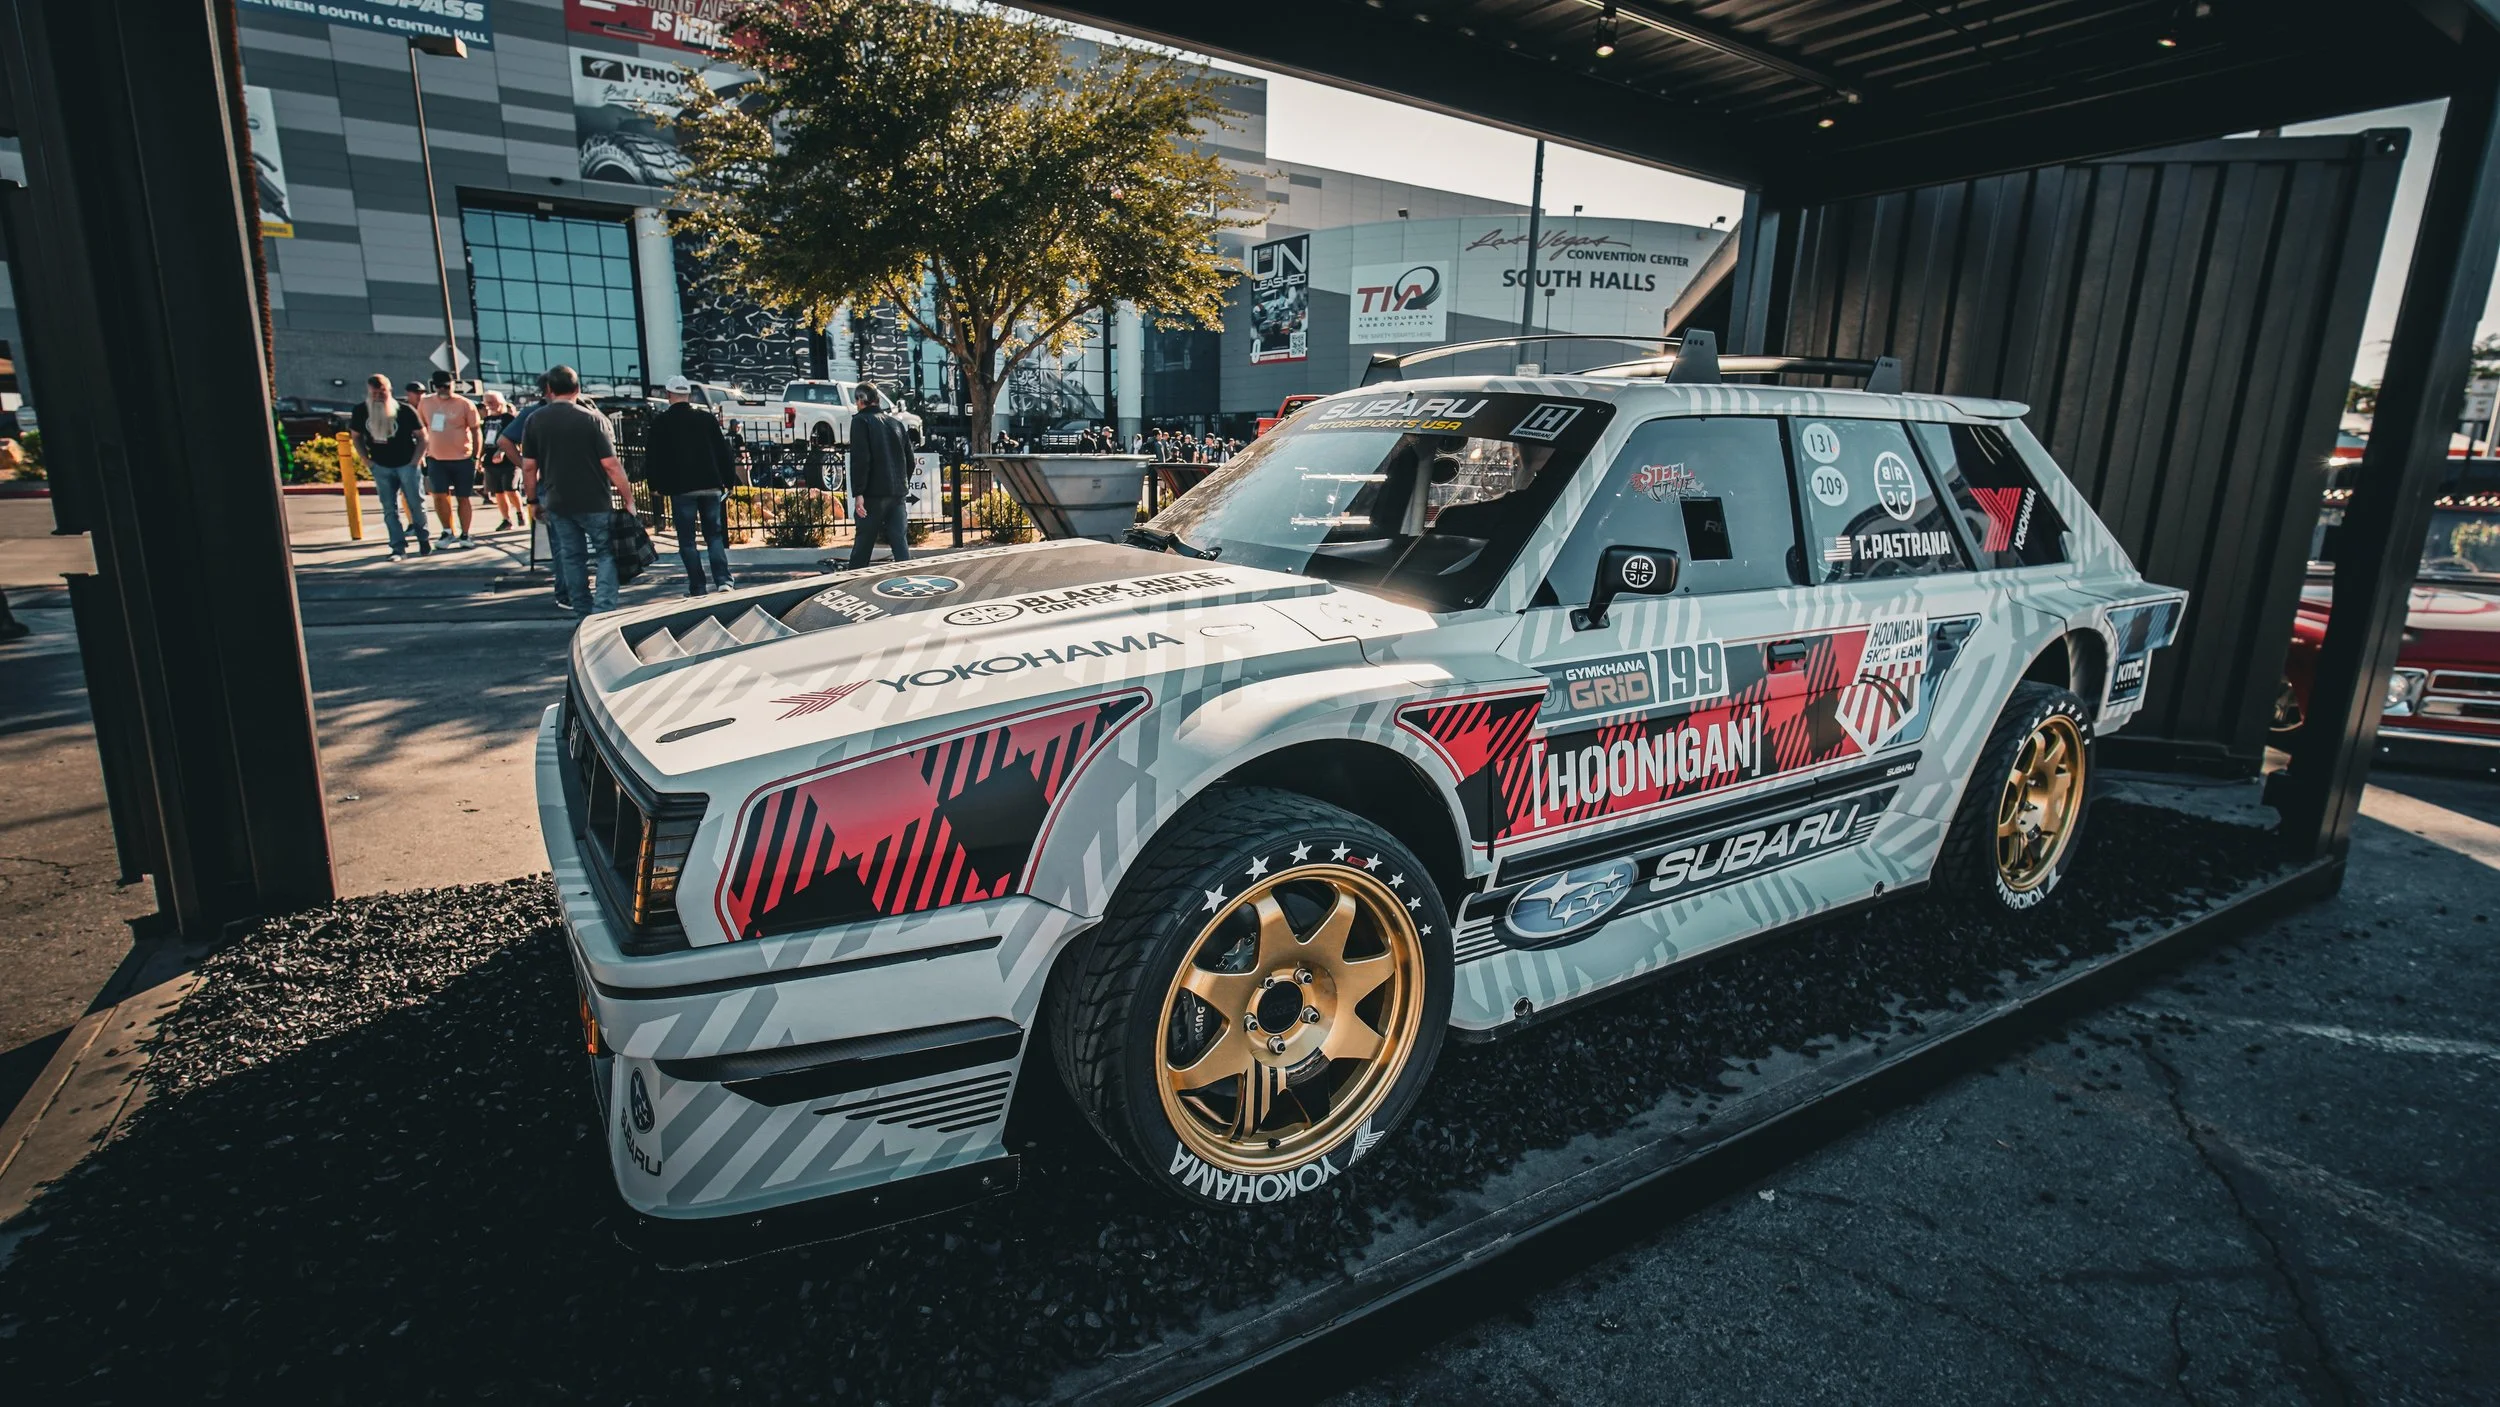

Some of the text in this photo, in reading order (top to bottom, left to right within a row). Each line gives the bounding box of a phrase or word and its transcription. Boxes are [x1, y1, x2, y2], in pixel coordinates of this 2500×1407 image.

[318, 4, 370, 23] SOUTH
[373, 14, 384, 25] &
[387, 17, 452, 37] CENTRAL
[454, 28, 489, 43] HALL
[651, 10, 673, 32] IS
[1465, 228, 1631, 261] Las Vegas
[1566, 249, 1689, 267] CONVENTION CENTER
[1253, 238, 1308, 281] UN
[1253, 273, 1306, 291] LEASHED
[1590, 271, 1656, 292] HALLS
[1357, 284, 1428, 313] TIA
[1318, 399, 1489, 420] SUBARU
[1529, 408, 1568, 430] H
[1303, 418, 1464, 431] MOTORSPORTS USA
[1810, 434, 1833, 453] 131
[908, 482, 928, 490] REA
[1640, 462, 1693, 485] STEEL
[1817, 475, 1843, 495] 209
[2013, 487, 2037, 550] YOKOHAMA
[1016, 571, 1223, 608] BLACK RIFLE
[1032, 578, 1237, 614] COFFEE COMPANY
[813, 589, 893, 623] SUBARU
[1869, 619, 1923, 647] HOONIGAN
[877, 632, 1184, 693] YOKOHAMA
[1895, 644, 1923, 660] TEAM
[1565, 659, 1646, 681] GYMKHANA
[1650, 642, 1723, 704] 199
[1886, 762, 1915, 777] SUBARU
[1649, 803, 1861, 892] SUBARU
[1996, 868, 2045, 911] YOKOHAMA
[621, 1107, 663, 1177] SUBARU
[1169, 1141, 1341, 1204] YOKOHAMA
